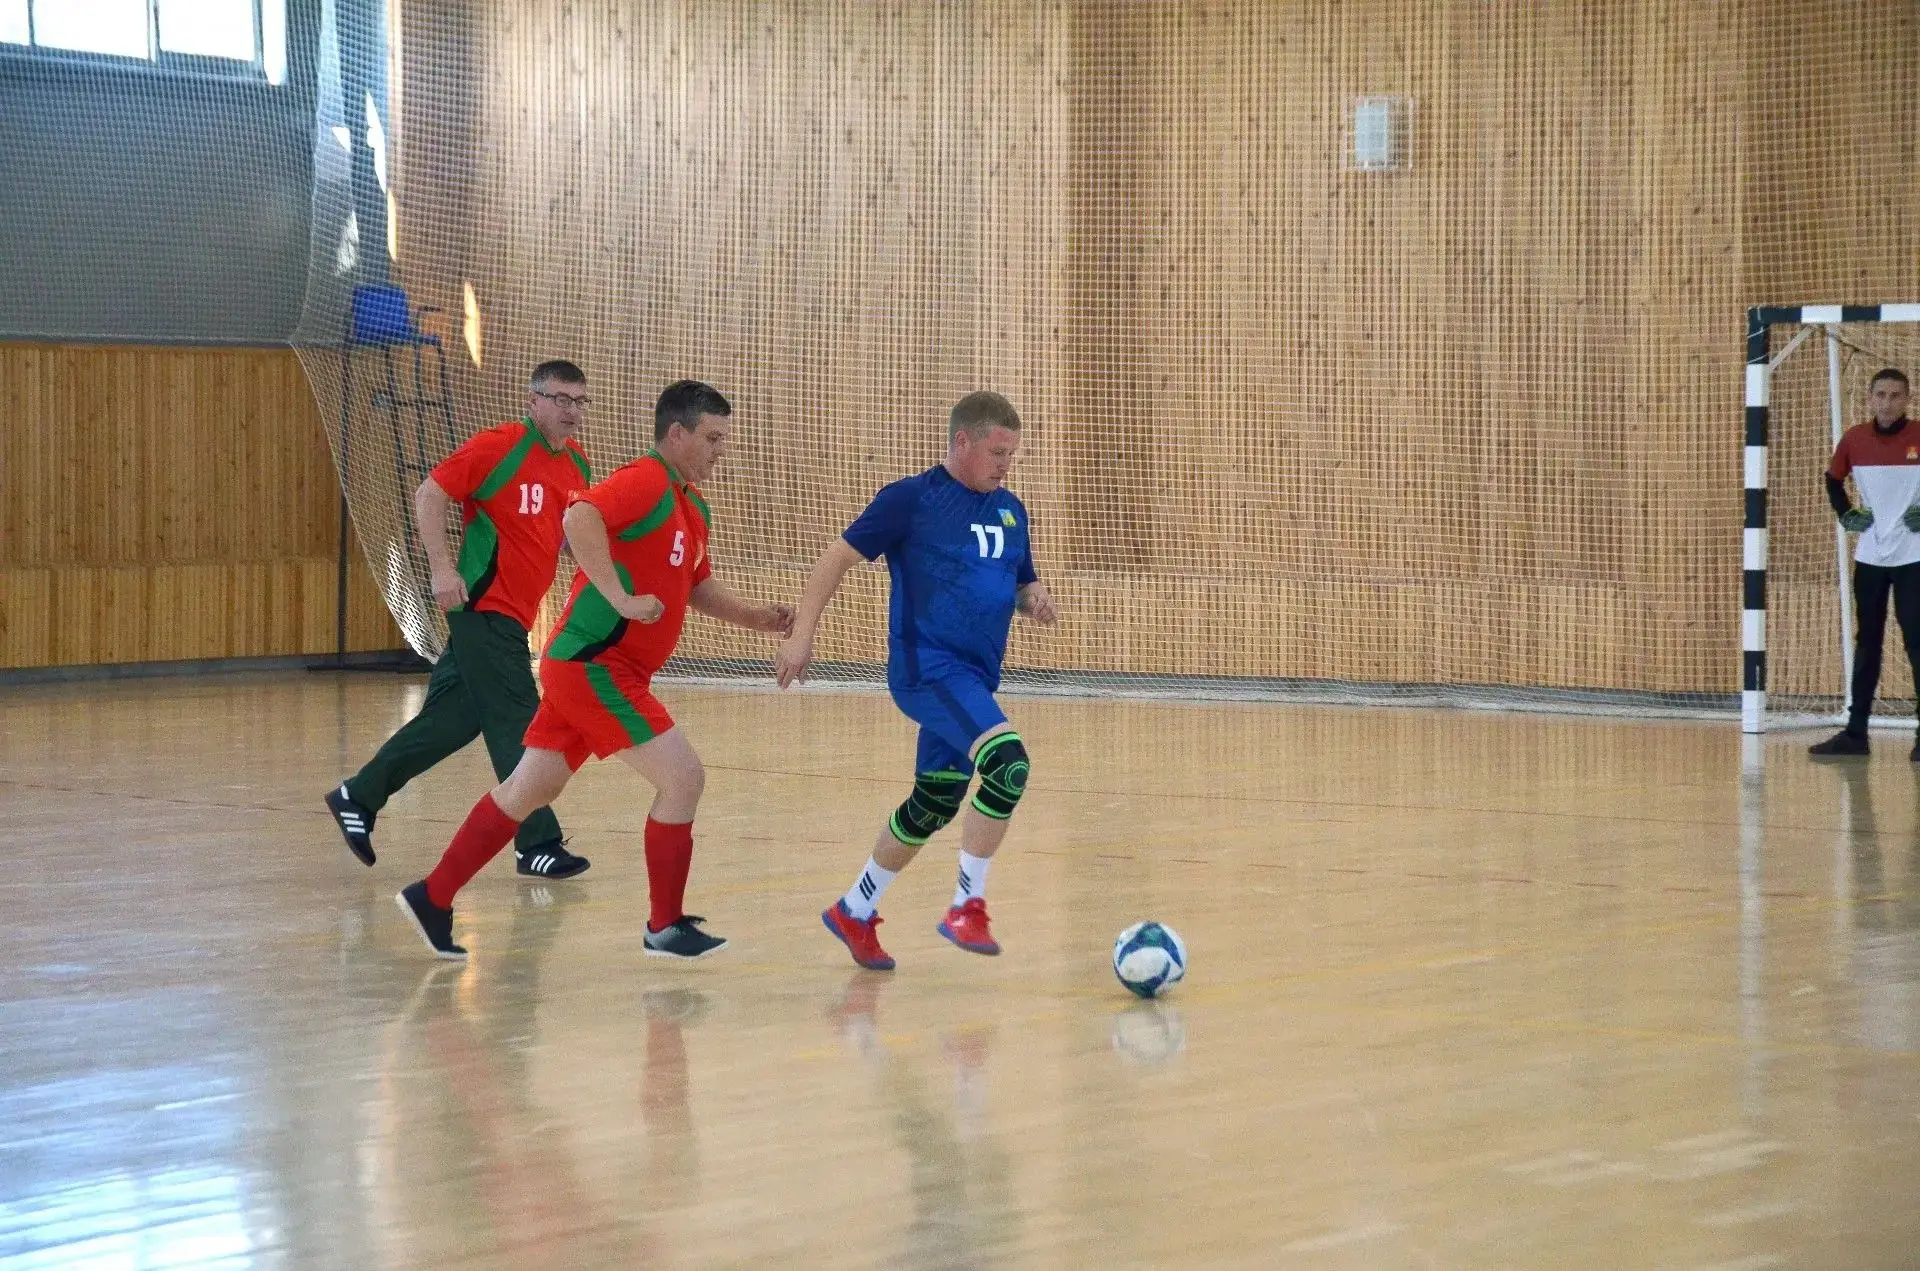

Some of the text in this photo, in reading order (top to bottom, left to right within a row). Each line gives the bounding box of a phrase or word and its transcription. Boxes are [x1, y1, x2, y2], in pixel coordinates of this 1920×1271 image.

[519, 483, 544, 515] 19
[669, 530, 685, 567] 5
[970, 523, 1005, 559] 17
